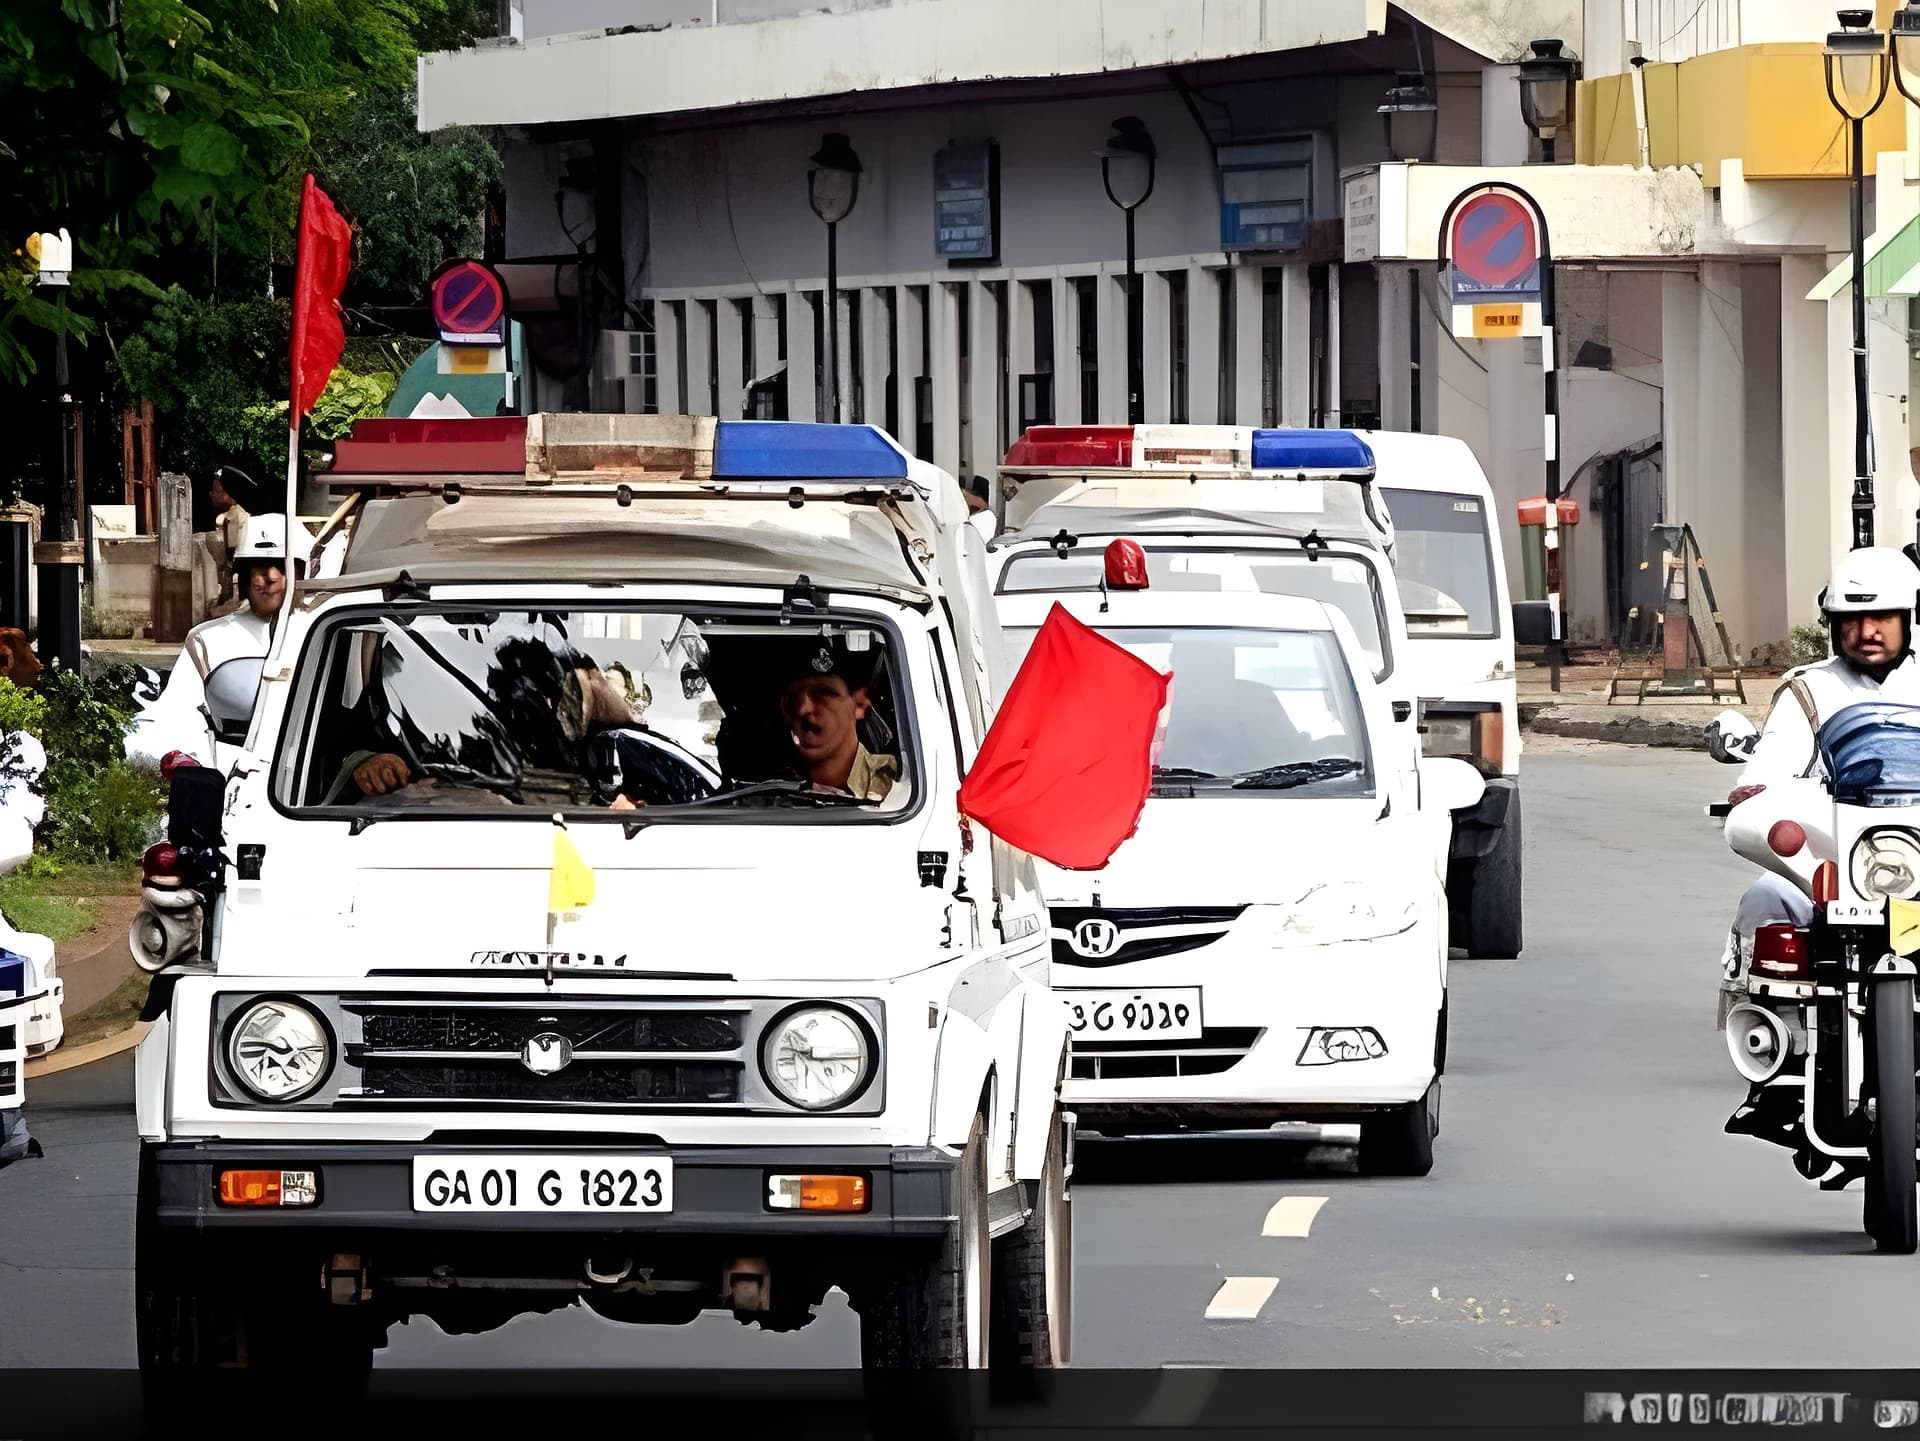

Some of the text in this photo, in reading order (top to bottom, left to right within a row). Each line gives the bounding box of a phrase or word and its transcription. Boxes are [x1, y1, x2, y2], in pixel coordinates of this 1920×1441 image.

[424, 1168, 664, 1207] GA 01 G 1823
